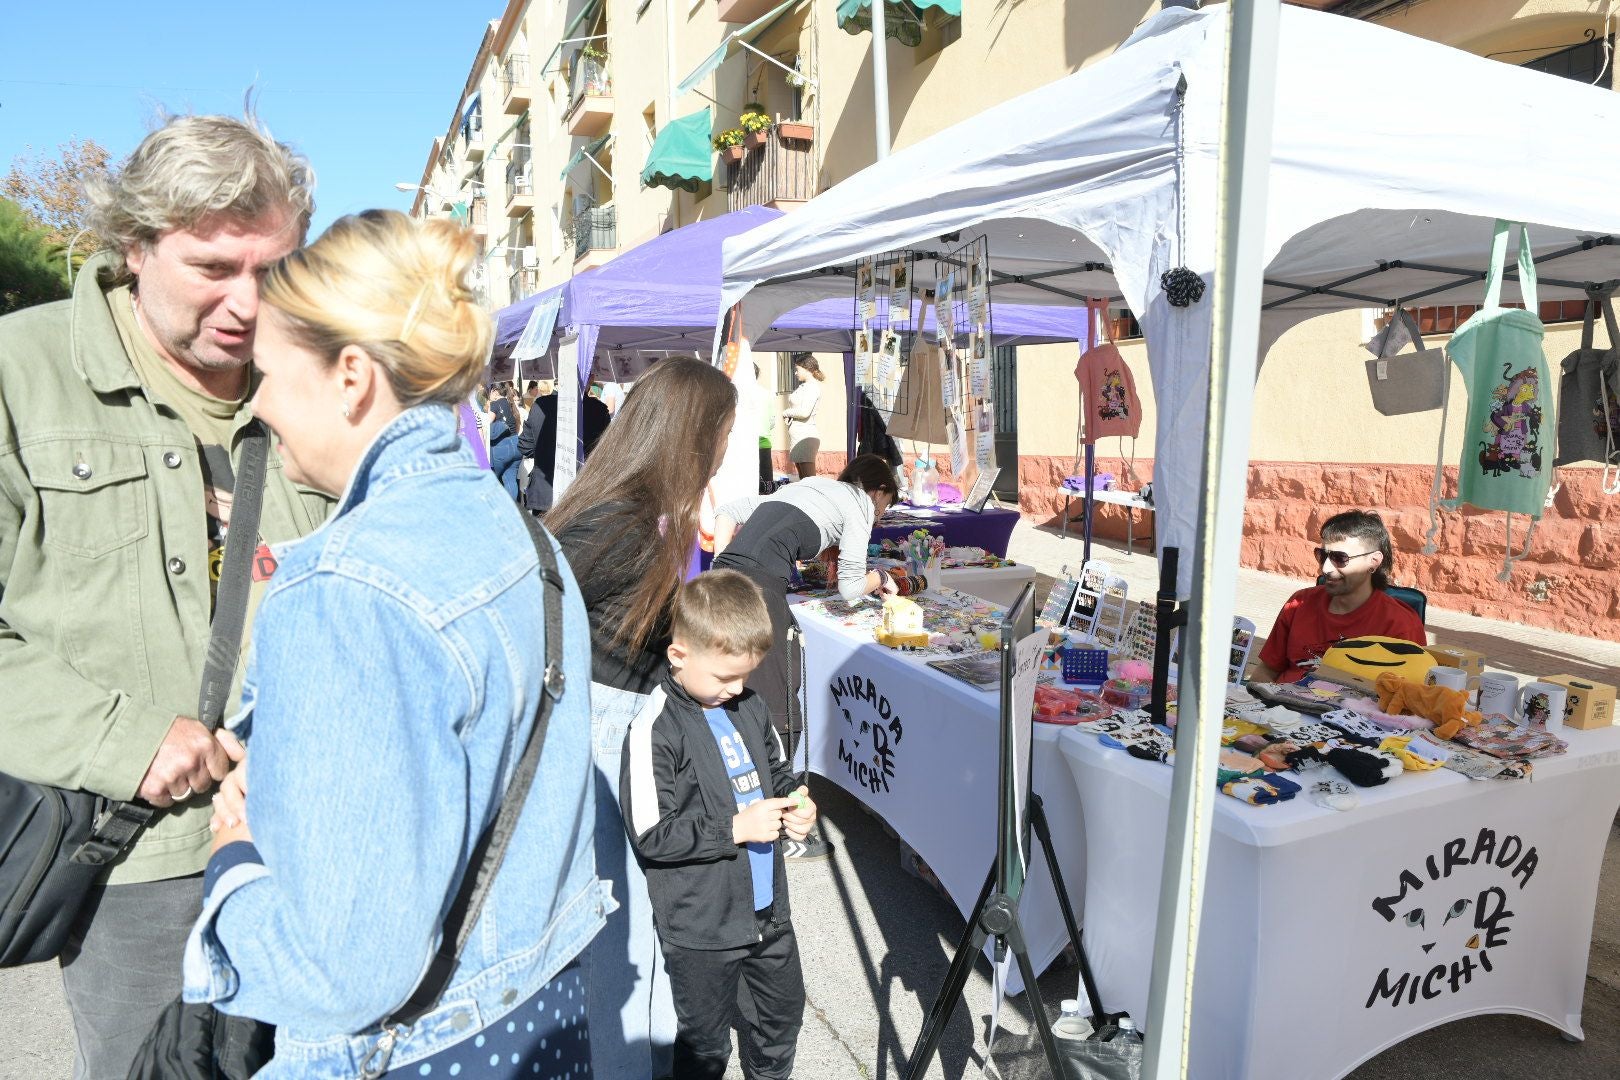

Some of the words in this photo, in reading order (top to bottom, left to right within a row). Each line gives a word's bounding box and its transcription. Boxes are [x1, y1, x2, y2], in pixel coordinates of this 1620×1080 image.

[830, 674, 903, 745] MIRADA
[838, 738, 889, 793] MICHI
[872, 722, 896, 778] DE
[1371, 827, 1539, 922] MIRADA
[1473, 886, 1515, 948] DE
[1365, 949, 1493, 1008] MICHI
